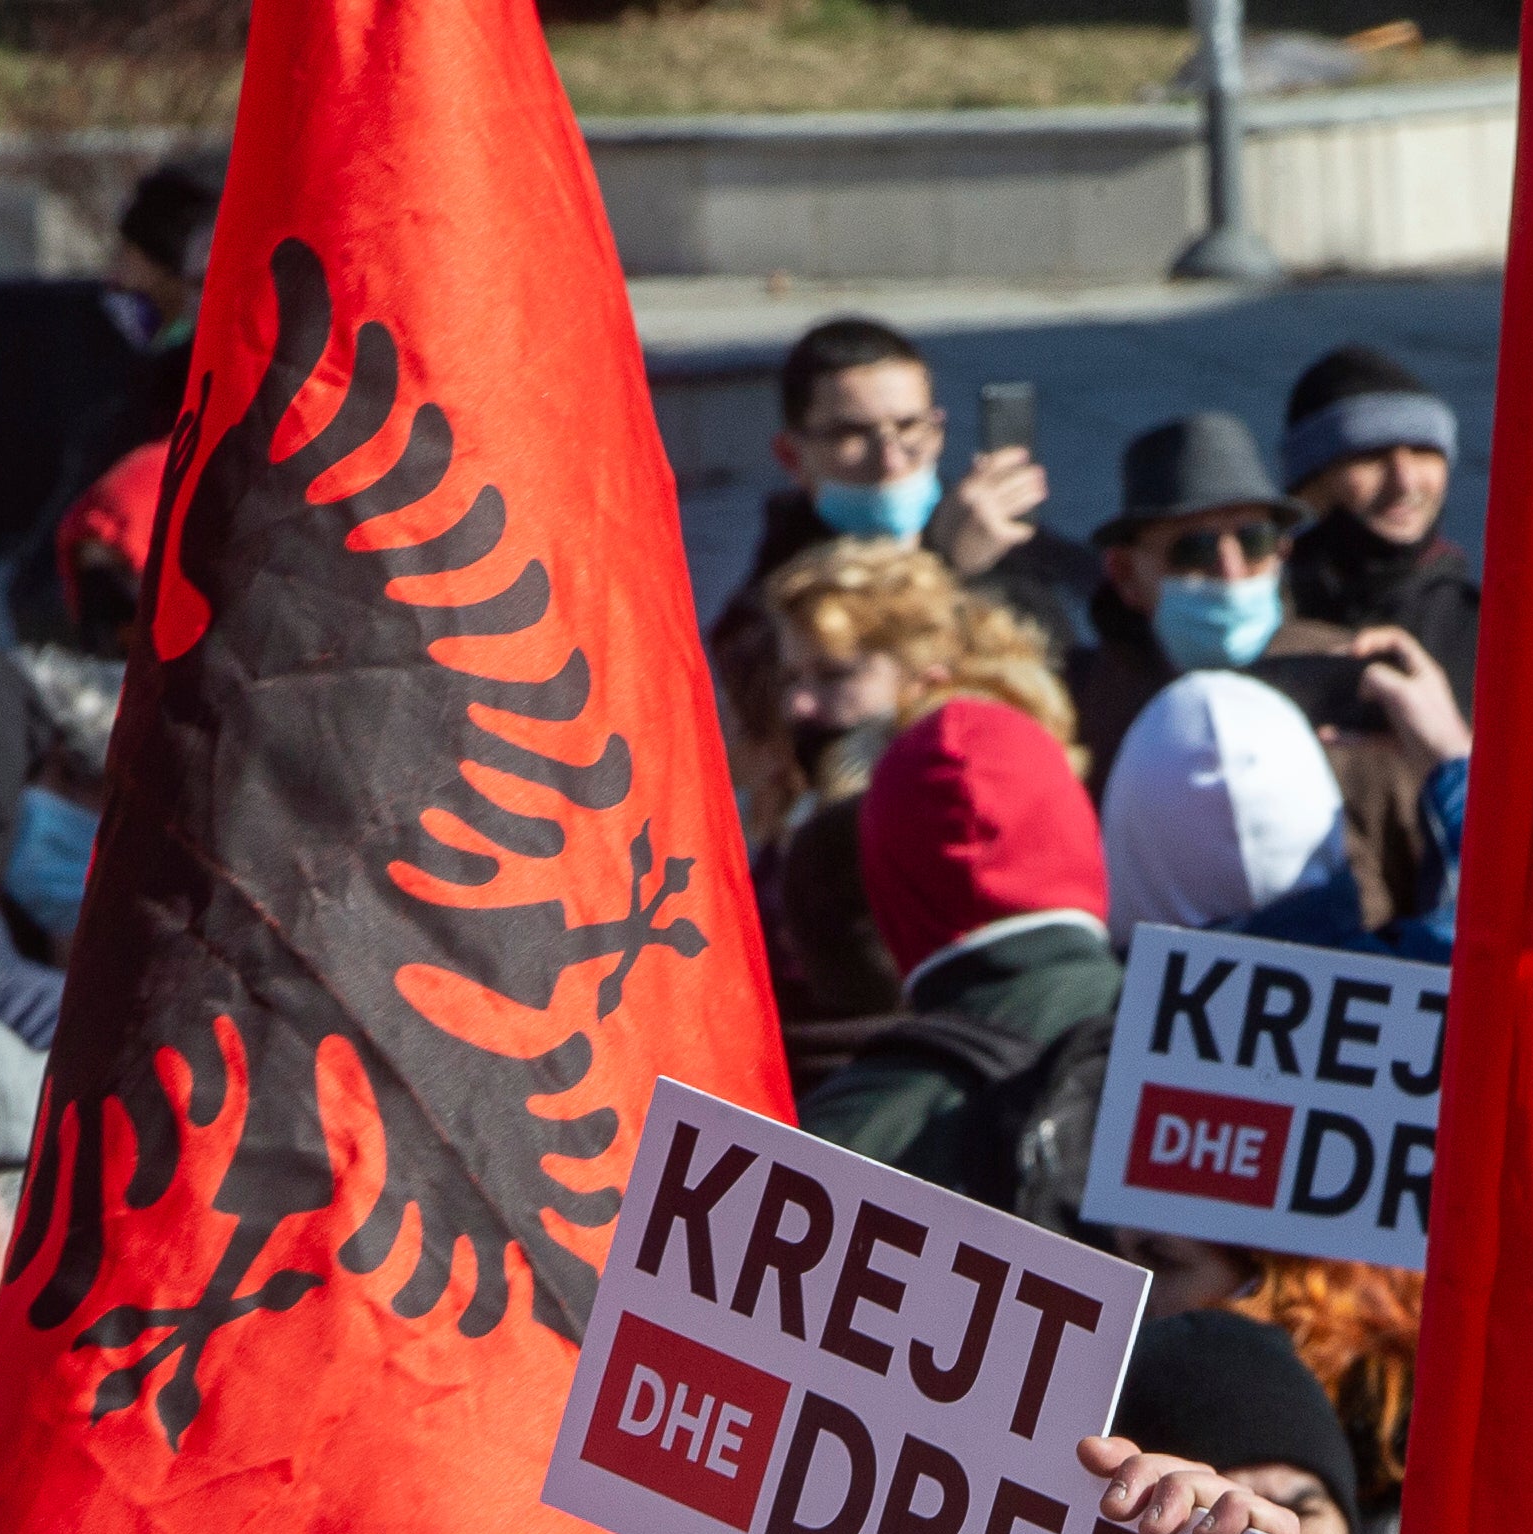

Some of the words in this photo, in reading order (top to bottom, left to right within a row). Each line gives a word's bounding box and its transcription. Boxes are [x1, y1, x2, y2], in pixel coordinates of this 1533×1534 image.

[1149, 950, 1449, 1098] KREJ
[1149, 1113, 1267, 1181] DHE
[1289, 1107, 1438, 1235] DR
[635, 1121, 1103, 1441] KREJT
[616, 1364, 753, 1480] DHE
